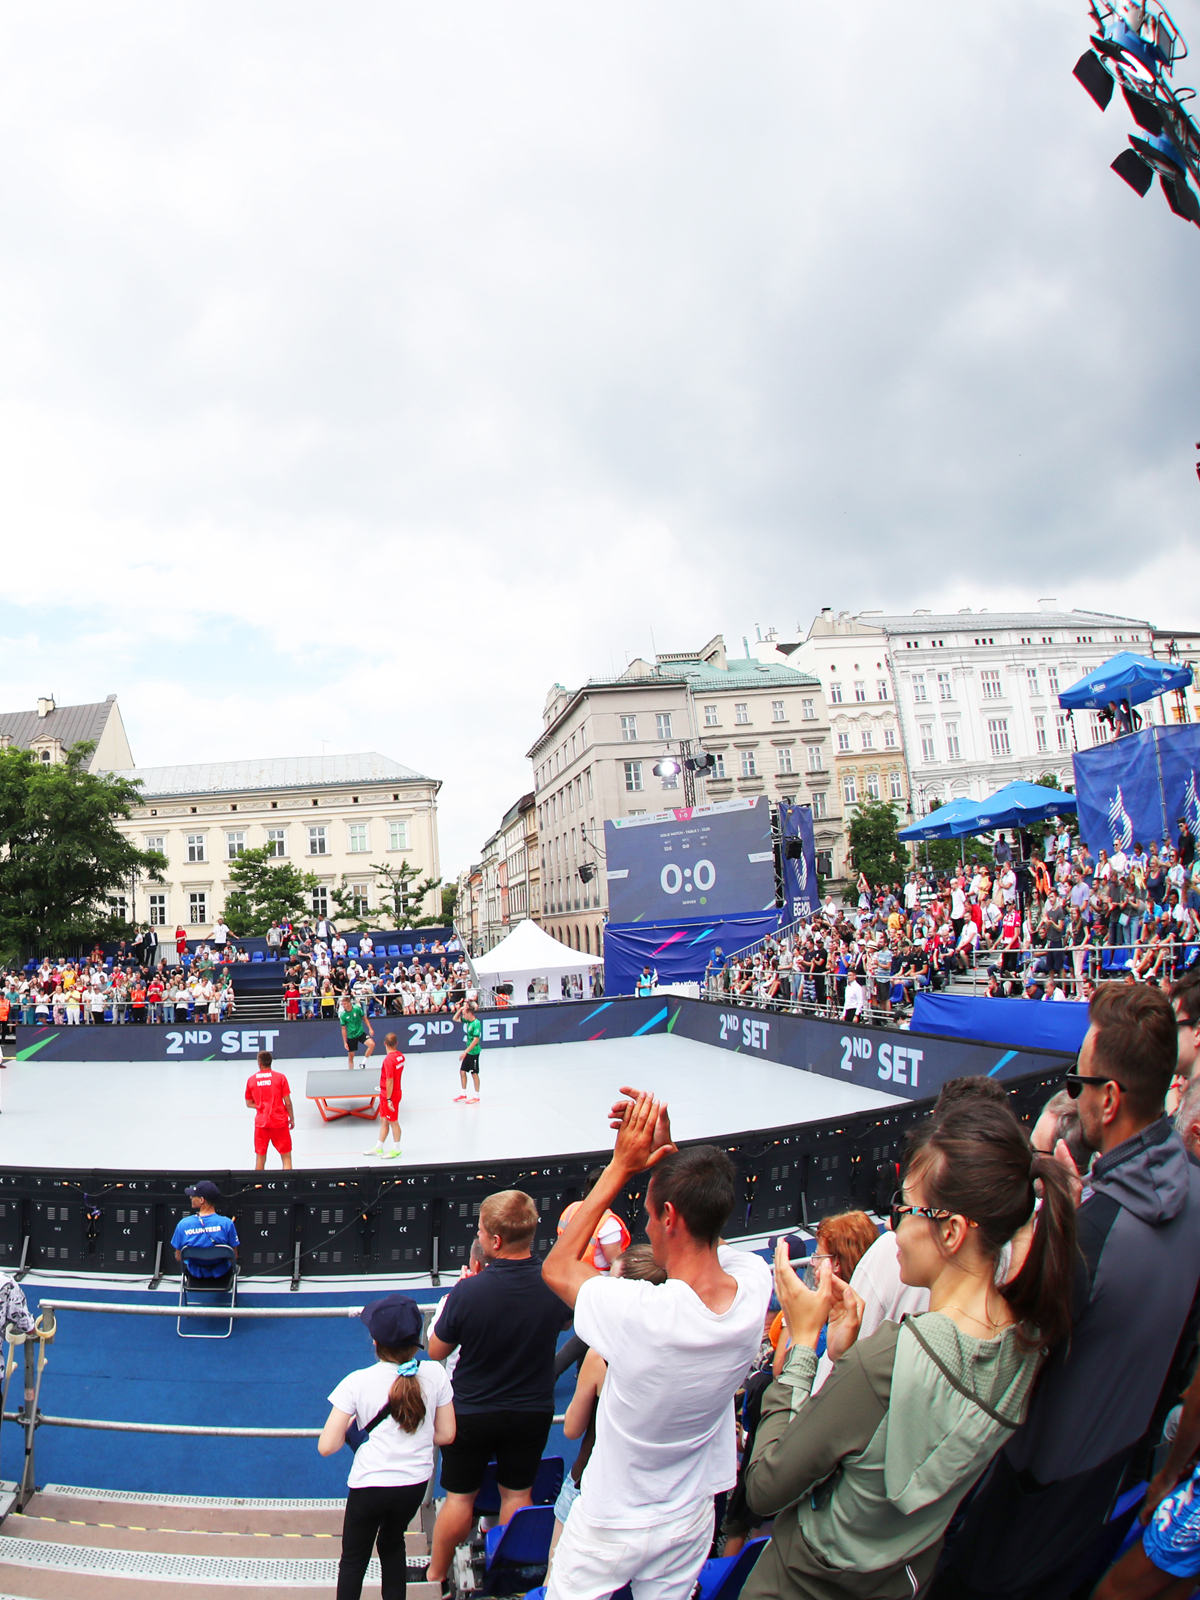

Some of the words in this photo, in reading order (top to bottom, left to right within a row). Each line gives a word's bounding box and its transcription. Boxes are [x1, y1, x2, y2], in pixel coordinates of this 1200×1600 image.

[661, 859, 716, 895] 0:0
[165, 1030, 213, 1054] 2ND
[221, 1029, 280, 1054] SET
[408, 1020, 454, 1046] 2ND
[463, 1016, 520, 1044] ET
[719, 1013, 740, 1040] 2ND
[742, 1018, 770, 1050] SET
[840, 1036, 872, 1072] 2ND
[877, 1042, 924, 1087] SET
[184, 1225, 221, 1236] VOLUNTEER
